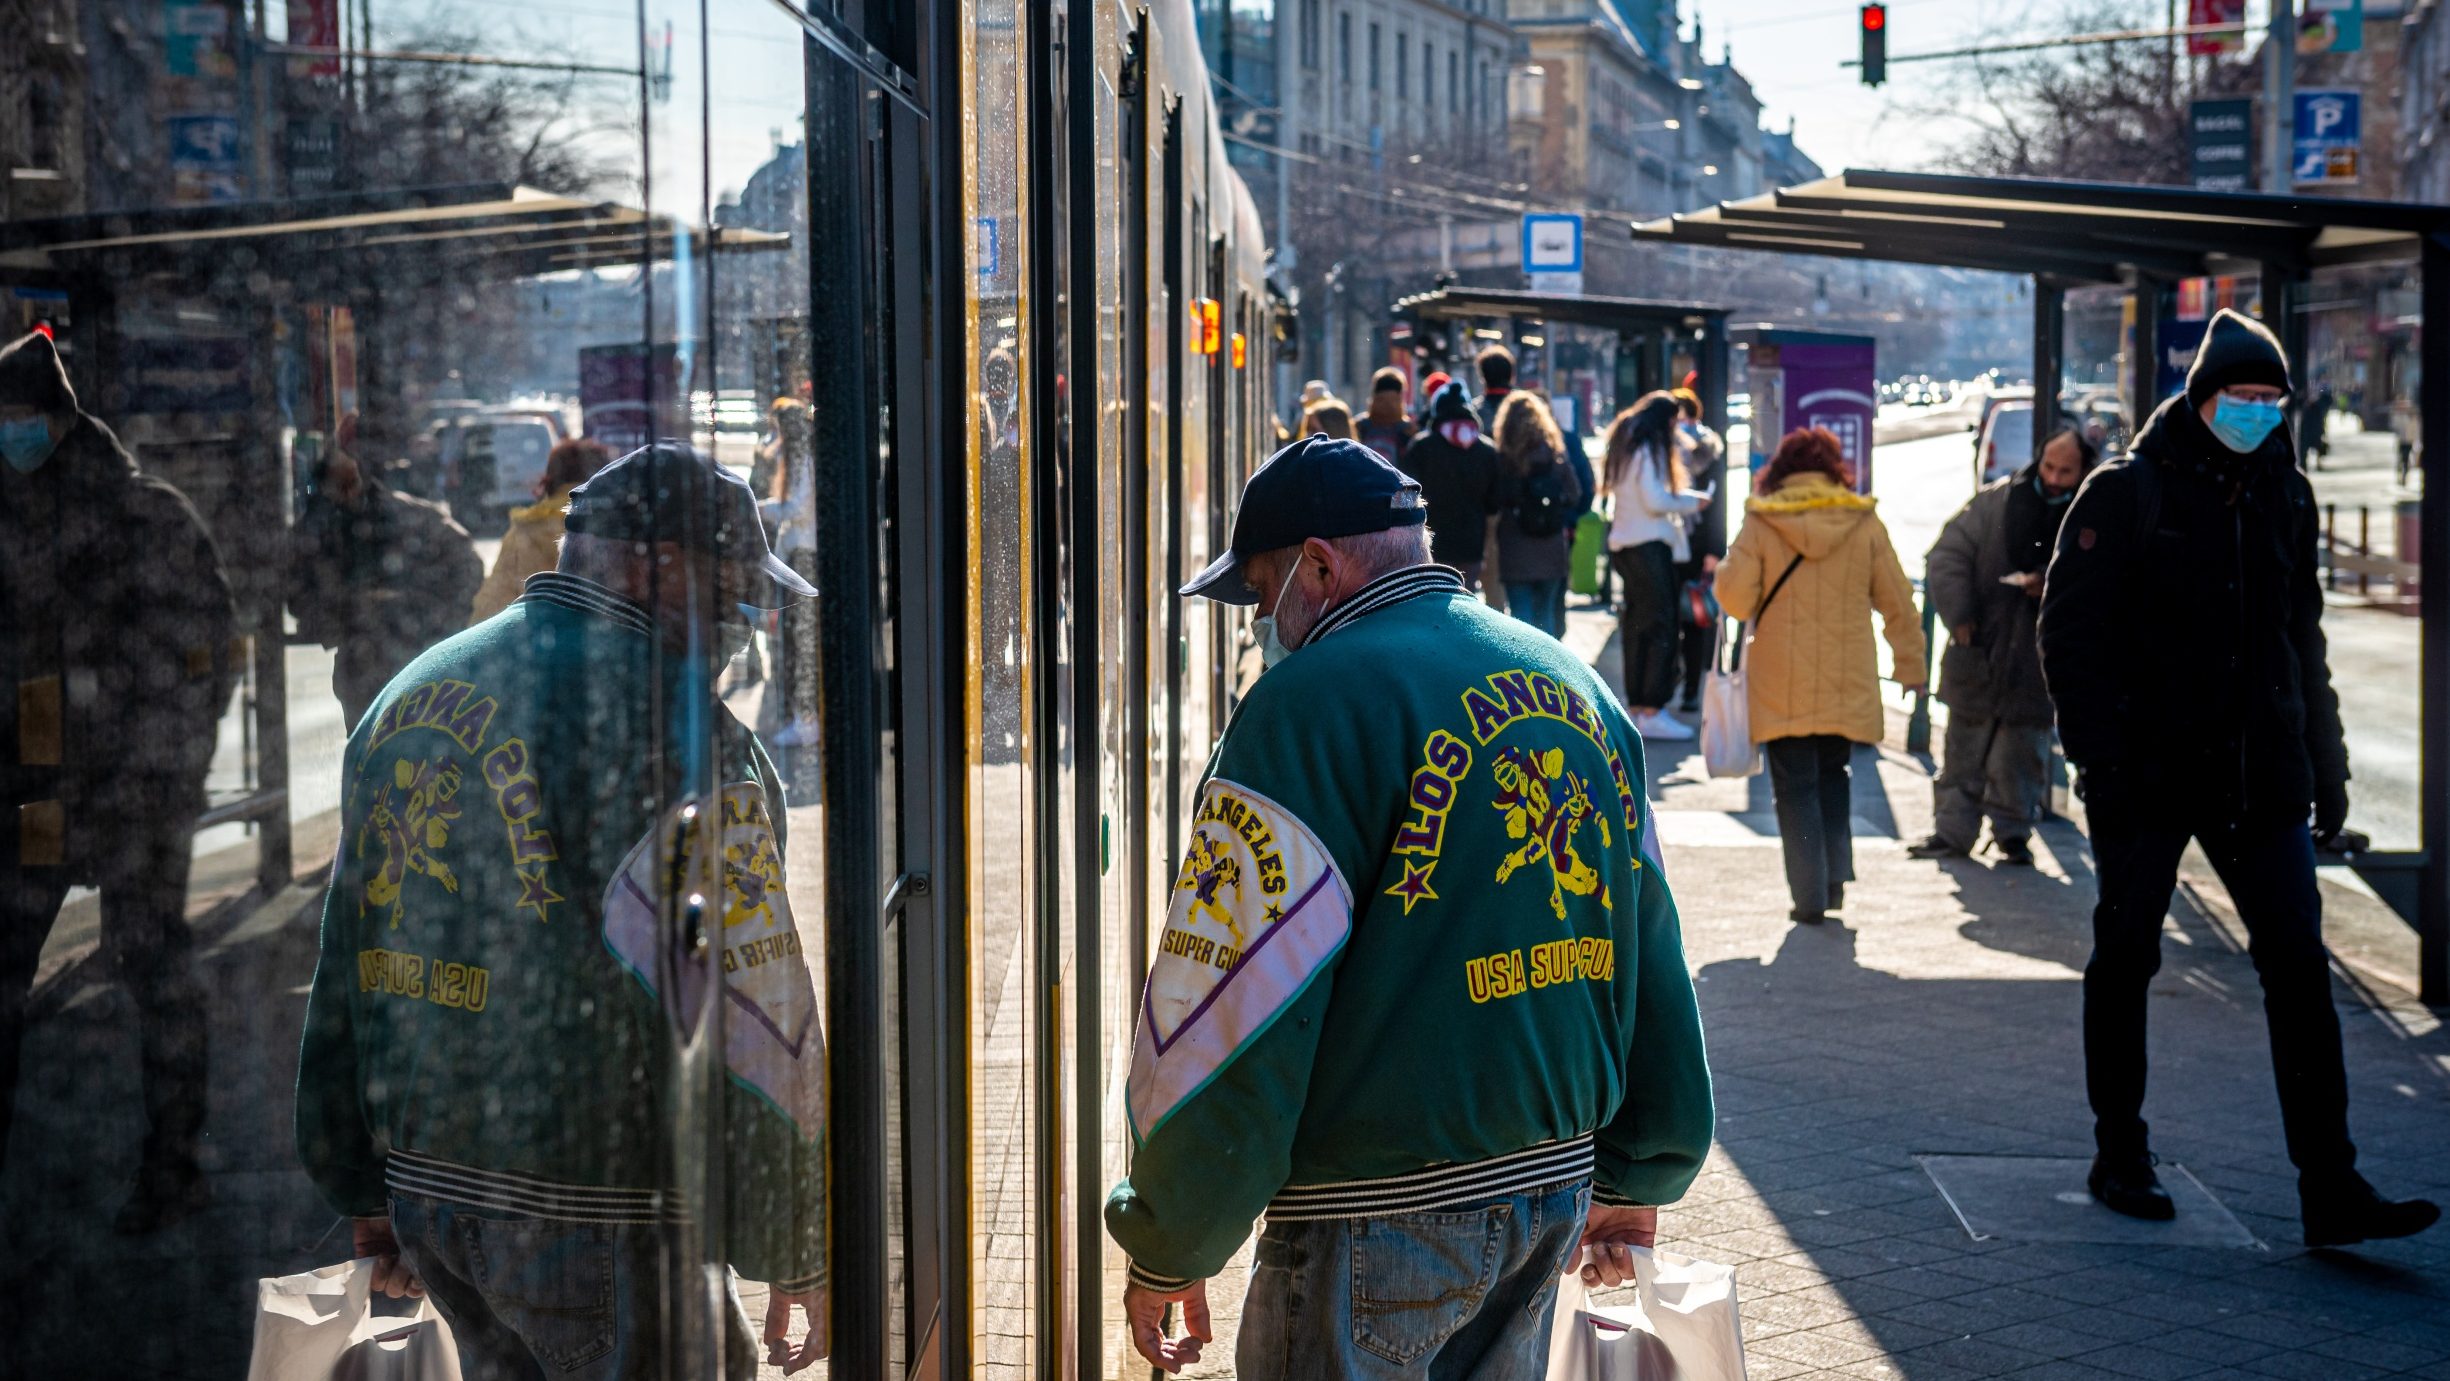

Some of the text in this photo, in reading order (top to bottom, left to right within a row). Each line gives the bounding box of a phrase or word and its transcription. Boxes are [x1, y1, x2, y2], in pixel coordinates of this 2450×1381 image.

[2195, 146, 2245, 161] COFFEE
[1390, 729, 1474, 857] LOS
[1198, 792, 1289, 897] ANGELES
[1163, 928, 1216, 965] SUPER
[1466, 949, 1527, 1004] USA
